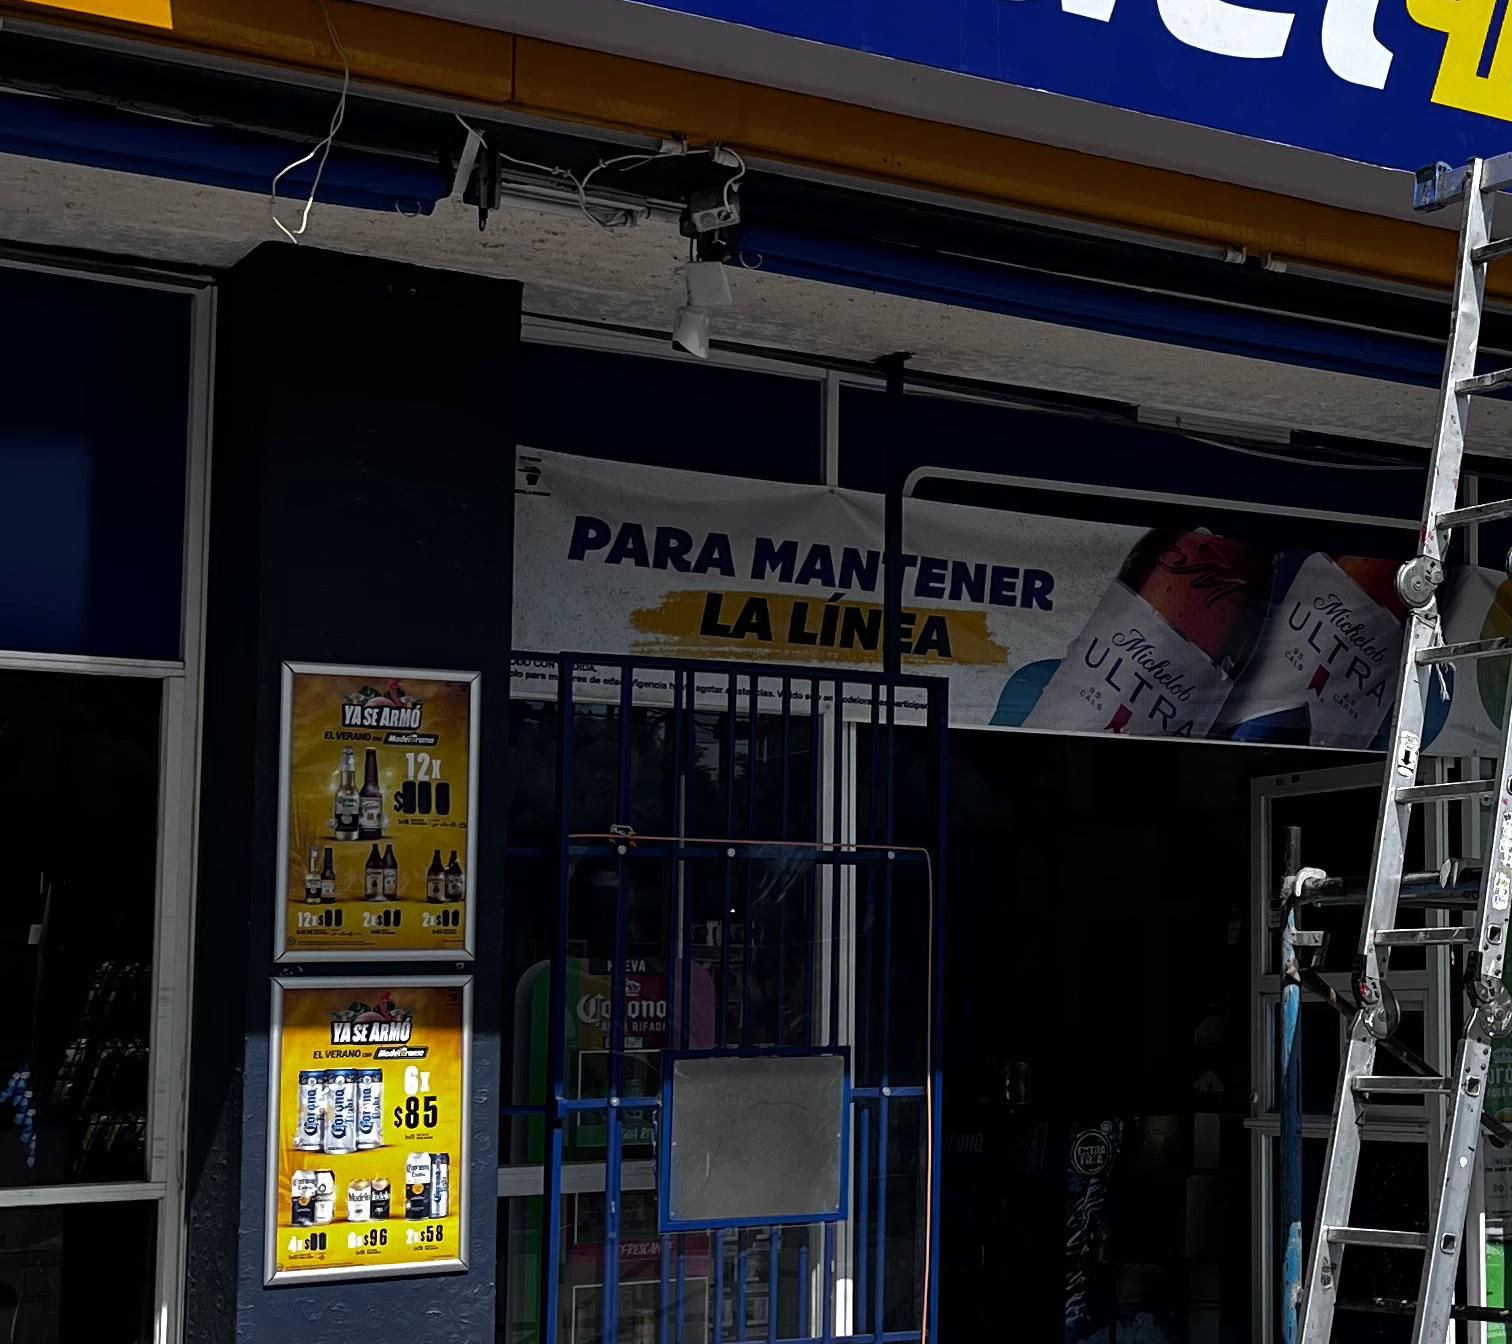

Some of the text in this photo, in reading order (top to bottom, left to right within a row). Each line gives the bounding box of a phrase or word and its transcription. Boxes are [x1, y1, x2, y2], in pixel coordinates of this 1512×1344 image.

[567, 515, 736, 577] PARA
[700, 592, 774, 643] LA
[1288, 601, 1387, 707] ULTRA
[344, 704, 421, 729] YA SE ARMÓ
[324, 731, 335, 740] EL
[336, 731, 372, 742] VERANO
[576, 993, 667, 1025] Coona
[333, 1017, 412, 1043] YA SE ARMÓ
[313, 1050, 324, 1059] EL
[325, 1049, 362, 1059] VERANO
[393, 1095, 439, 1130] $85
[420, 1225, 444, 1243] $58
